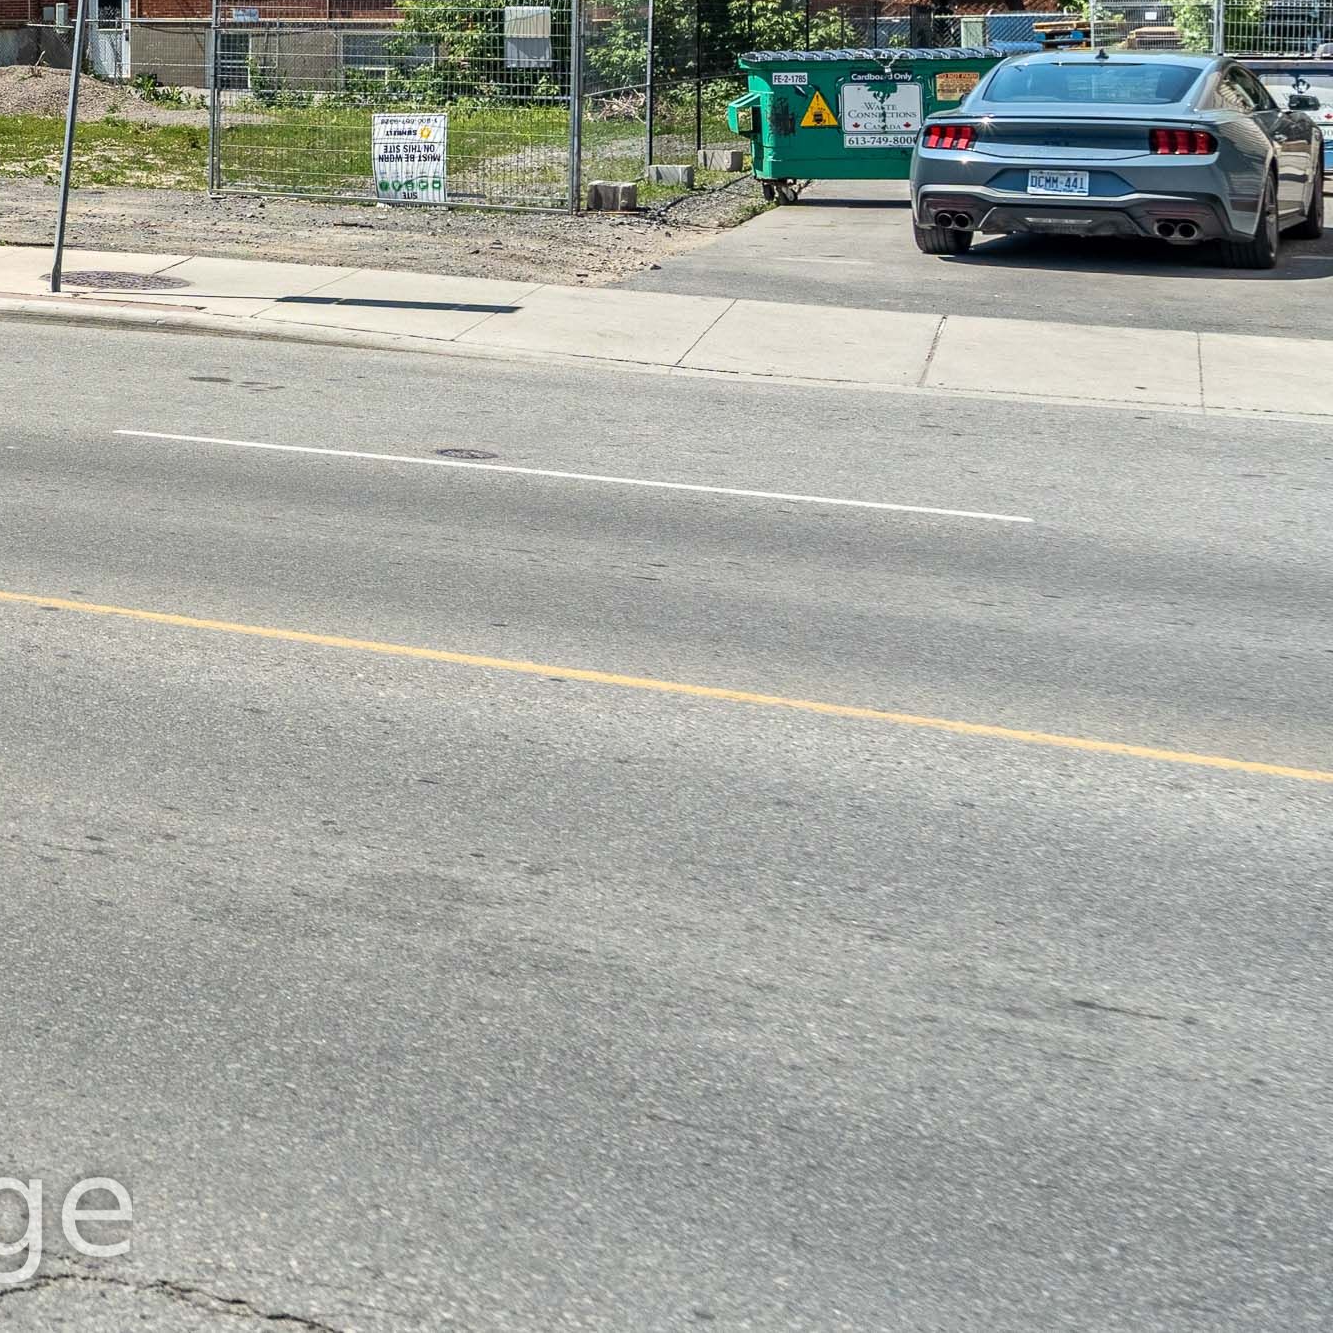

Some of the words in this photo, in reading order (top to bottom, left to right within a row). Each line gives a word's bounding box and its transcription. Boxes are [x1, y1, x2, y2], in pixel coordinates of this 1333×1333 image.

[773, 75, 807, 84] FE-2-1785
[894, 72, 912, 81] Only
[383, 144, 401, 153] SITE
[403, 144, 421, 153] THIS
[424, 144, 435, 153] ON
[378, 153, 403, 163] WORN
[405, 154, 416, 162] BE
[418, 153, 441, 162] MUST
